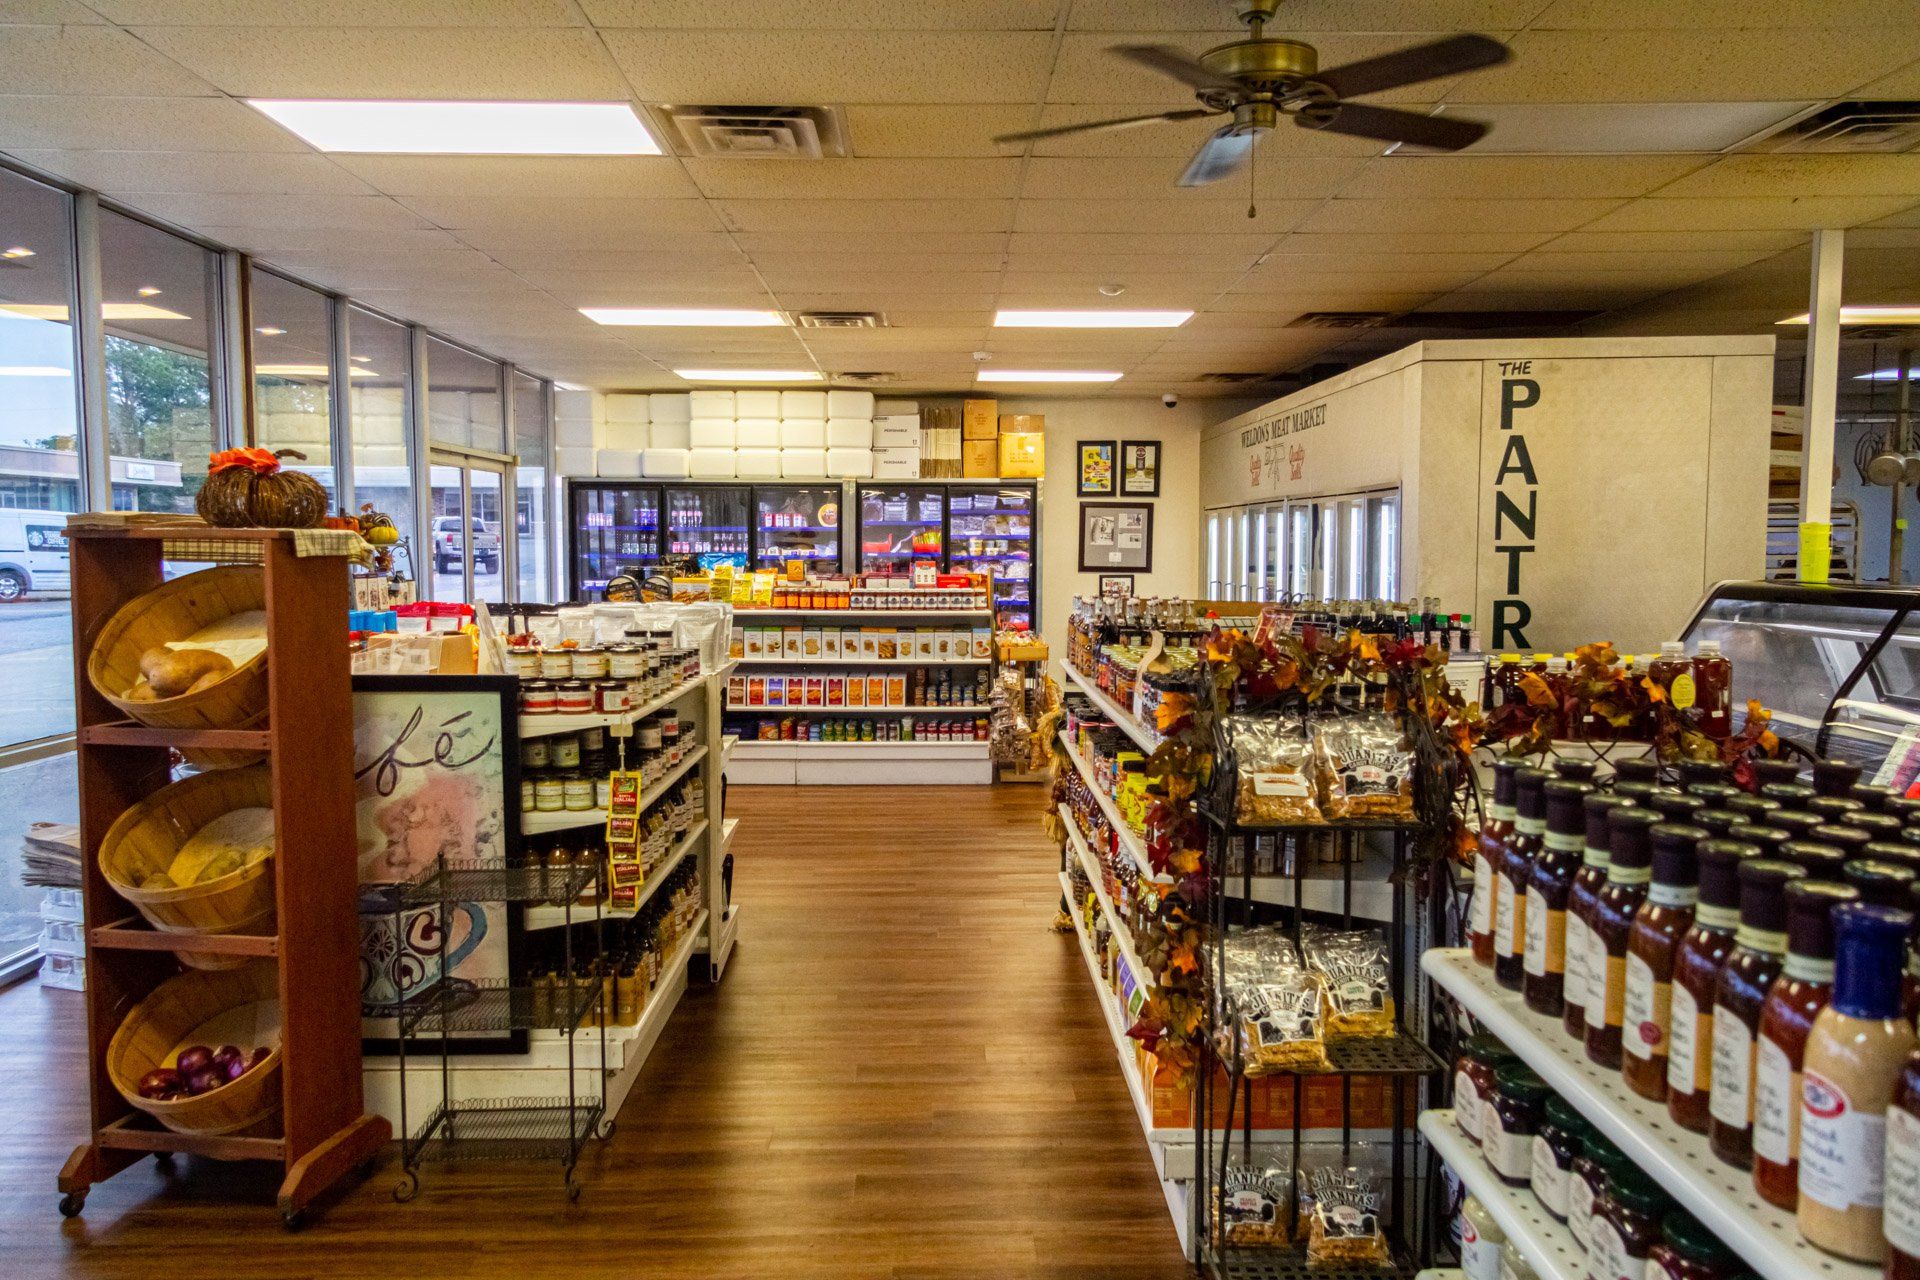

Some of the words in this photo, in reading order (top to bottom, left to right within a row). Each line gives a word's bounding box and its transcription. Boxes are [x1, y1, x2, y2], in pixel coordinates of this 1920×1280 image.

[1499, 361, 1532, 376] THE
[1241, 422, 1269, 449] WELDON'S
[1271, 416, 1290, 440] MEAT
[1292, 403, 1327, 433] MARKET
[1340, 748, 1401, 765] JUANITA'S
